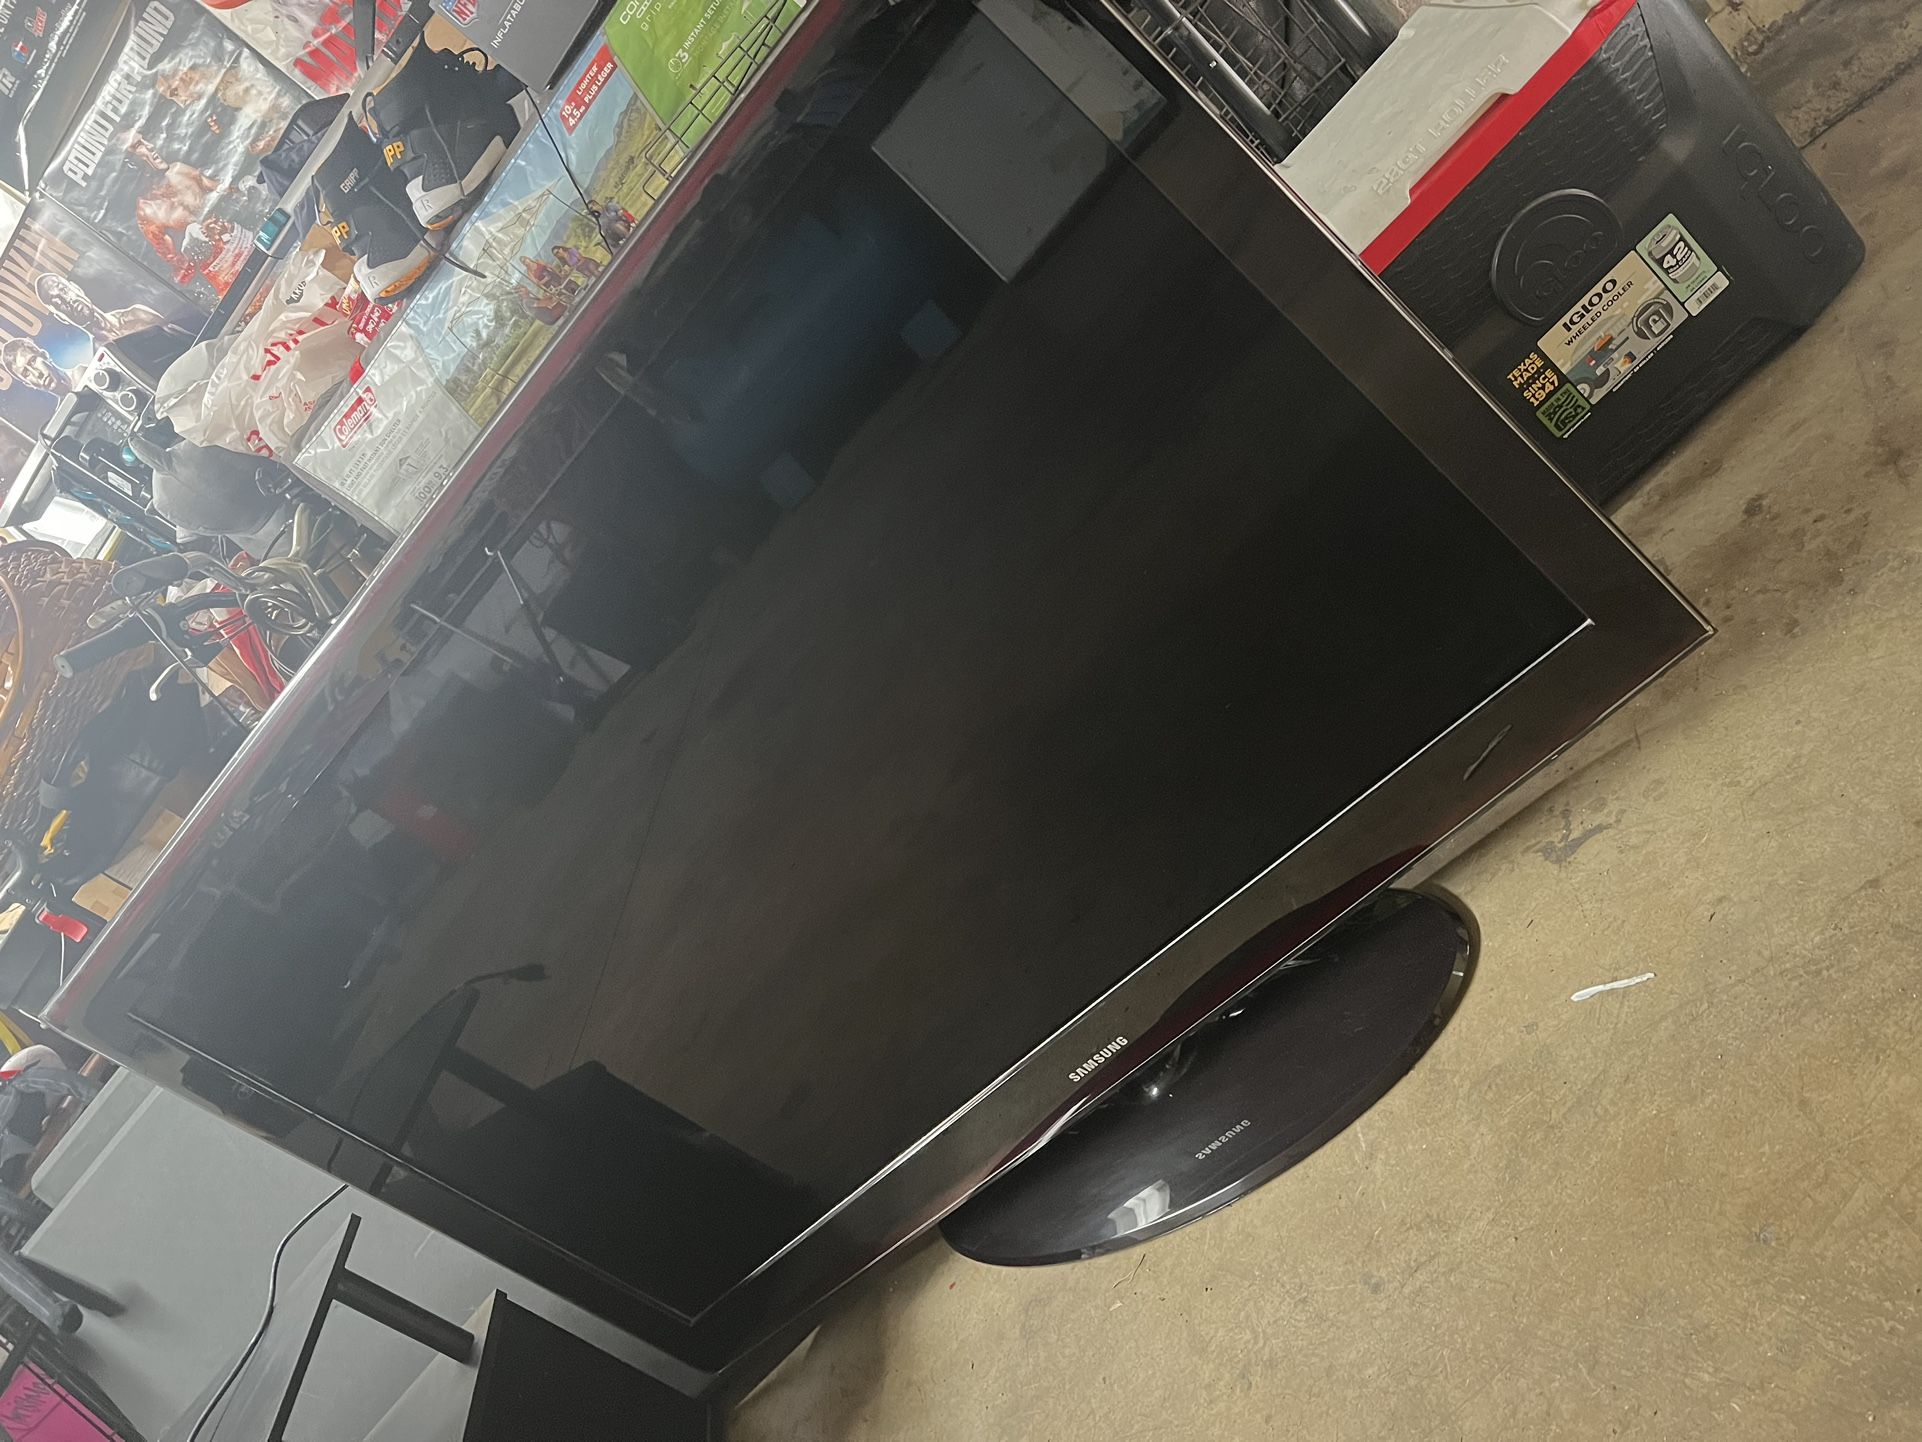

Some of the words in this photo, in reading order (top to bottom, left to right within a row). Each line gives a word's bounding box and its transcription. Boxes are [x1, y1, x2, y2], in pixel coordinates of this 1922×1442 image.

[490, 0, 529, 48] INFLATABL
[683, 19, 707, 50] INSTANT
[705, 0, 722, 19] SETU
[63, 111, 114, 188] POUND
[98, 71, 136, 123] FOR
[118, 0, 175, 82] POUND
[576, 63, 599, 96] LIGHTER
[584, 84, 598, 103] PLUS
[595, 62, 614, 87] LÉGER
[1662, 241, 1686, 270] 42
[1562, 278, 1618, 332] IGLOO
[1565, 310, 1602, 347] WHEELED
[1601, 280, 1634, 312] COOLER
[1507, 352, 1538, 381] TEXAS
[1513, 357, 1544, 388] MADE
[1523, 369, 1555, 400] SINCE
[1529, 375, 1559, 407] 1947
[335, 401, 370, 441] Coleman
[1068, 1036, 1129, 1083] SAMSUNG
